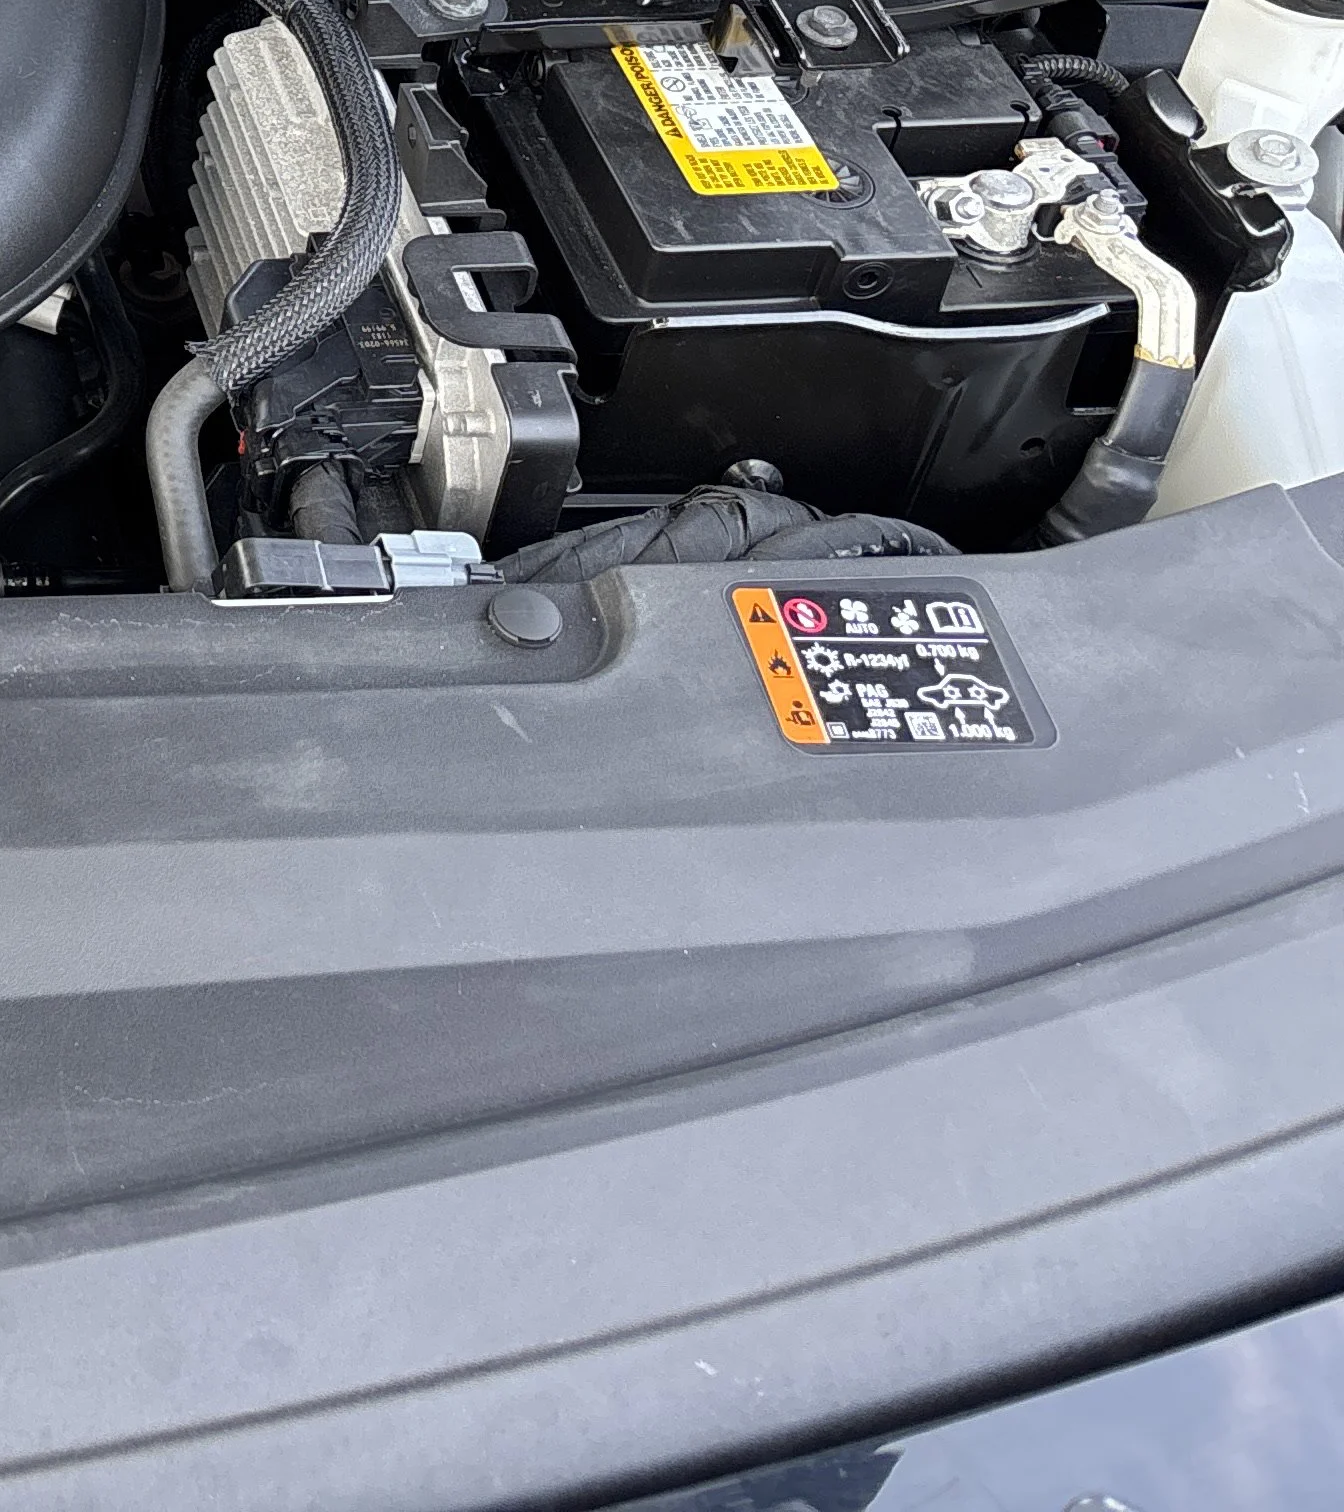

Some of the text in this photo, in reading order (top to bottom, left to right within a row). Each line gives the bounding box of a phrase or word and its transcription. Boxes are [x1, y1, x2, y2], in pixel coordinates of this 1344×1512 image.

[619, 45, 677, 127] DANGER/POISO
[845, 622, 879, 635] AUTO
[915, 643, 980, 661] 0.700 kg
[843, 653, 910, 671] R-1234yf
[855, 683, 890, 699] PAG
[948, 723, 1017, 741] 1.000 kg
